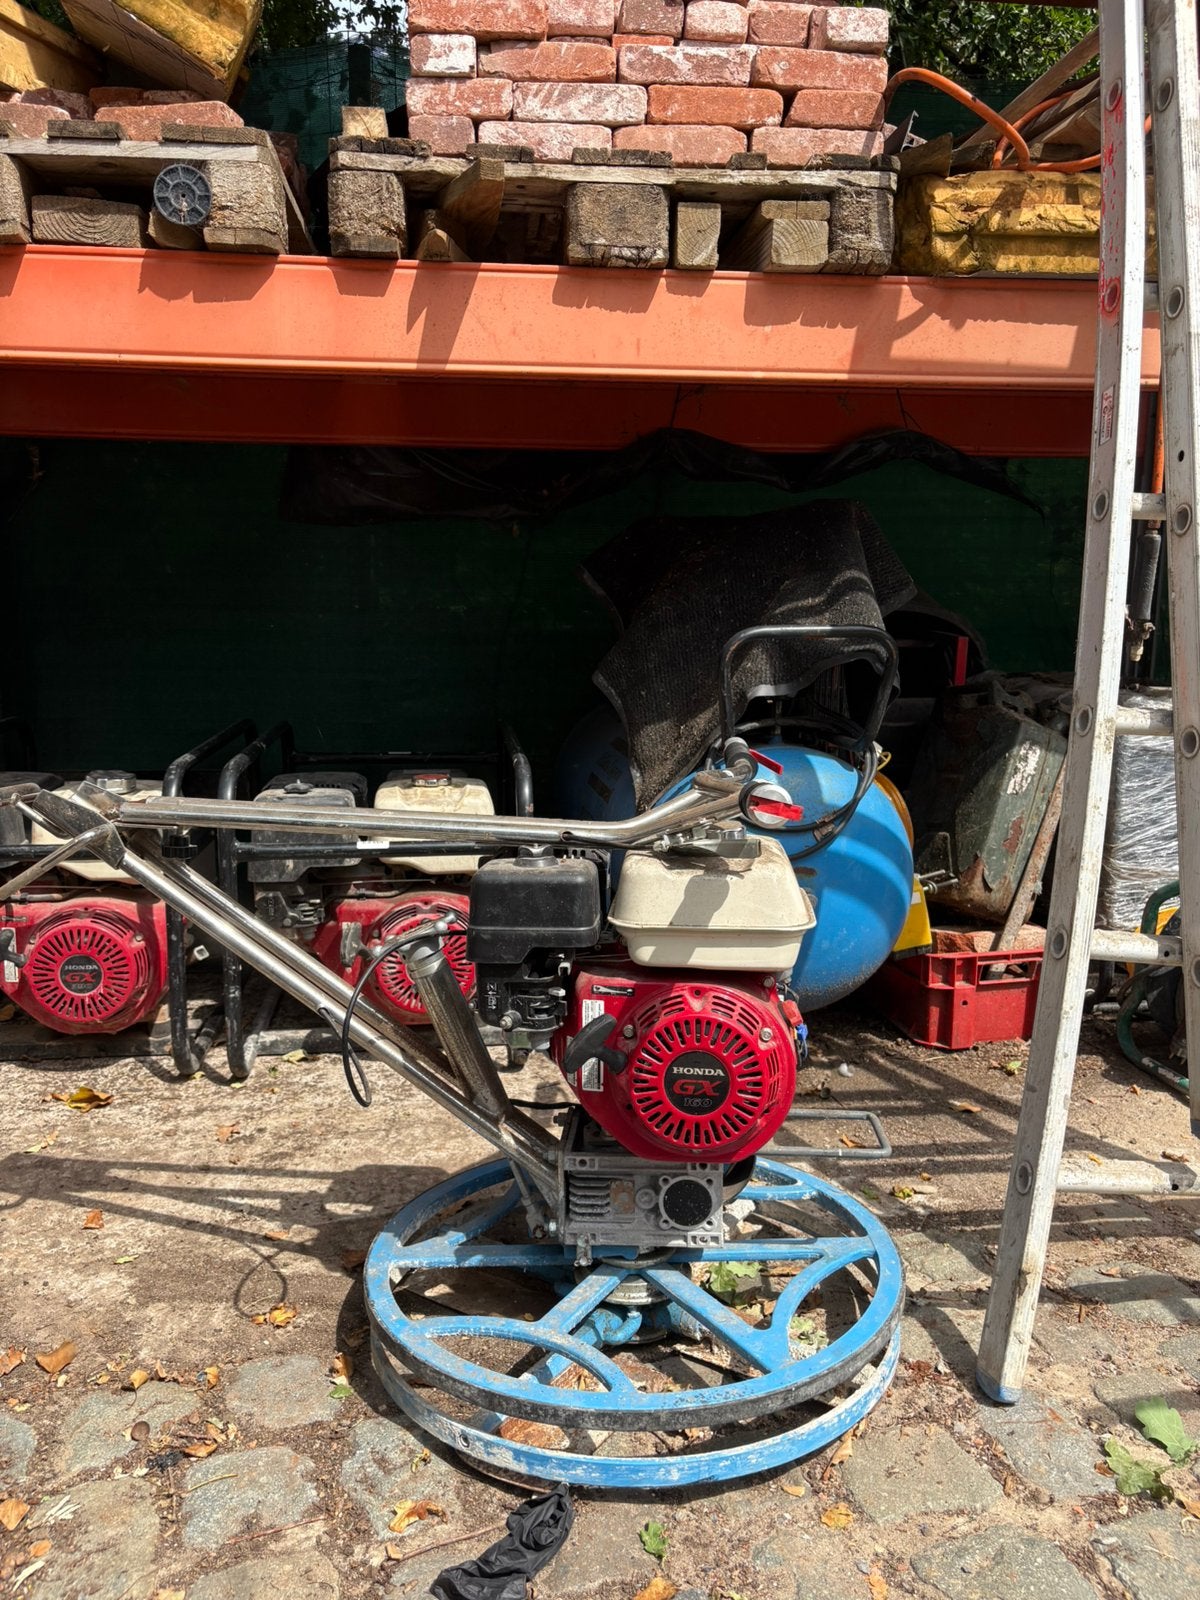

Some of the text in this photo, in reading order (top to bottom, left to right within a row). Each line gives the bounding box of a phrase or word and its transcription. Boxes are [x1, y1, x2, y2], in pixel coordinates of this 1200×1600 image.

[65, 972, 97, 983] GX
[672, 1066, 725, 1076] HONDA
[673, 1079, 721, 1096] GX
[684, 1098, 712, 1107] 160
